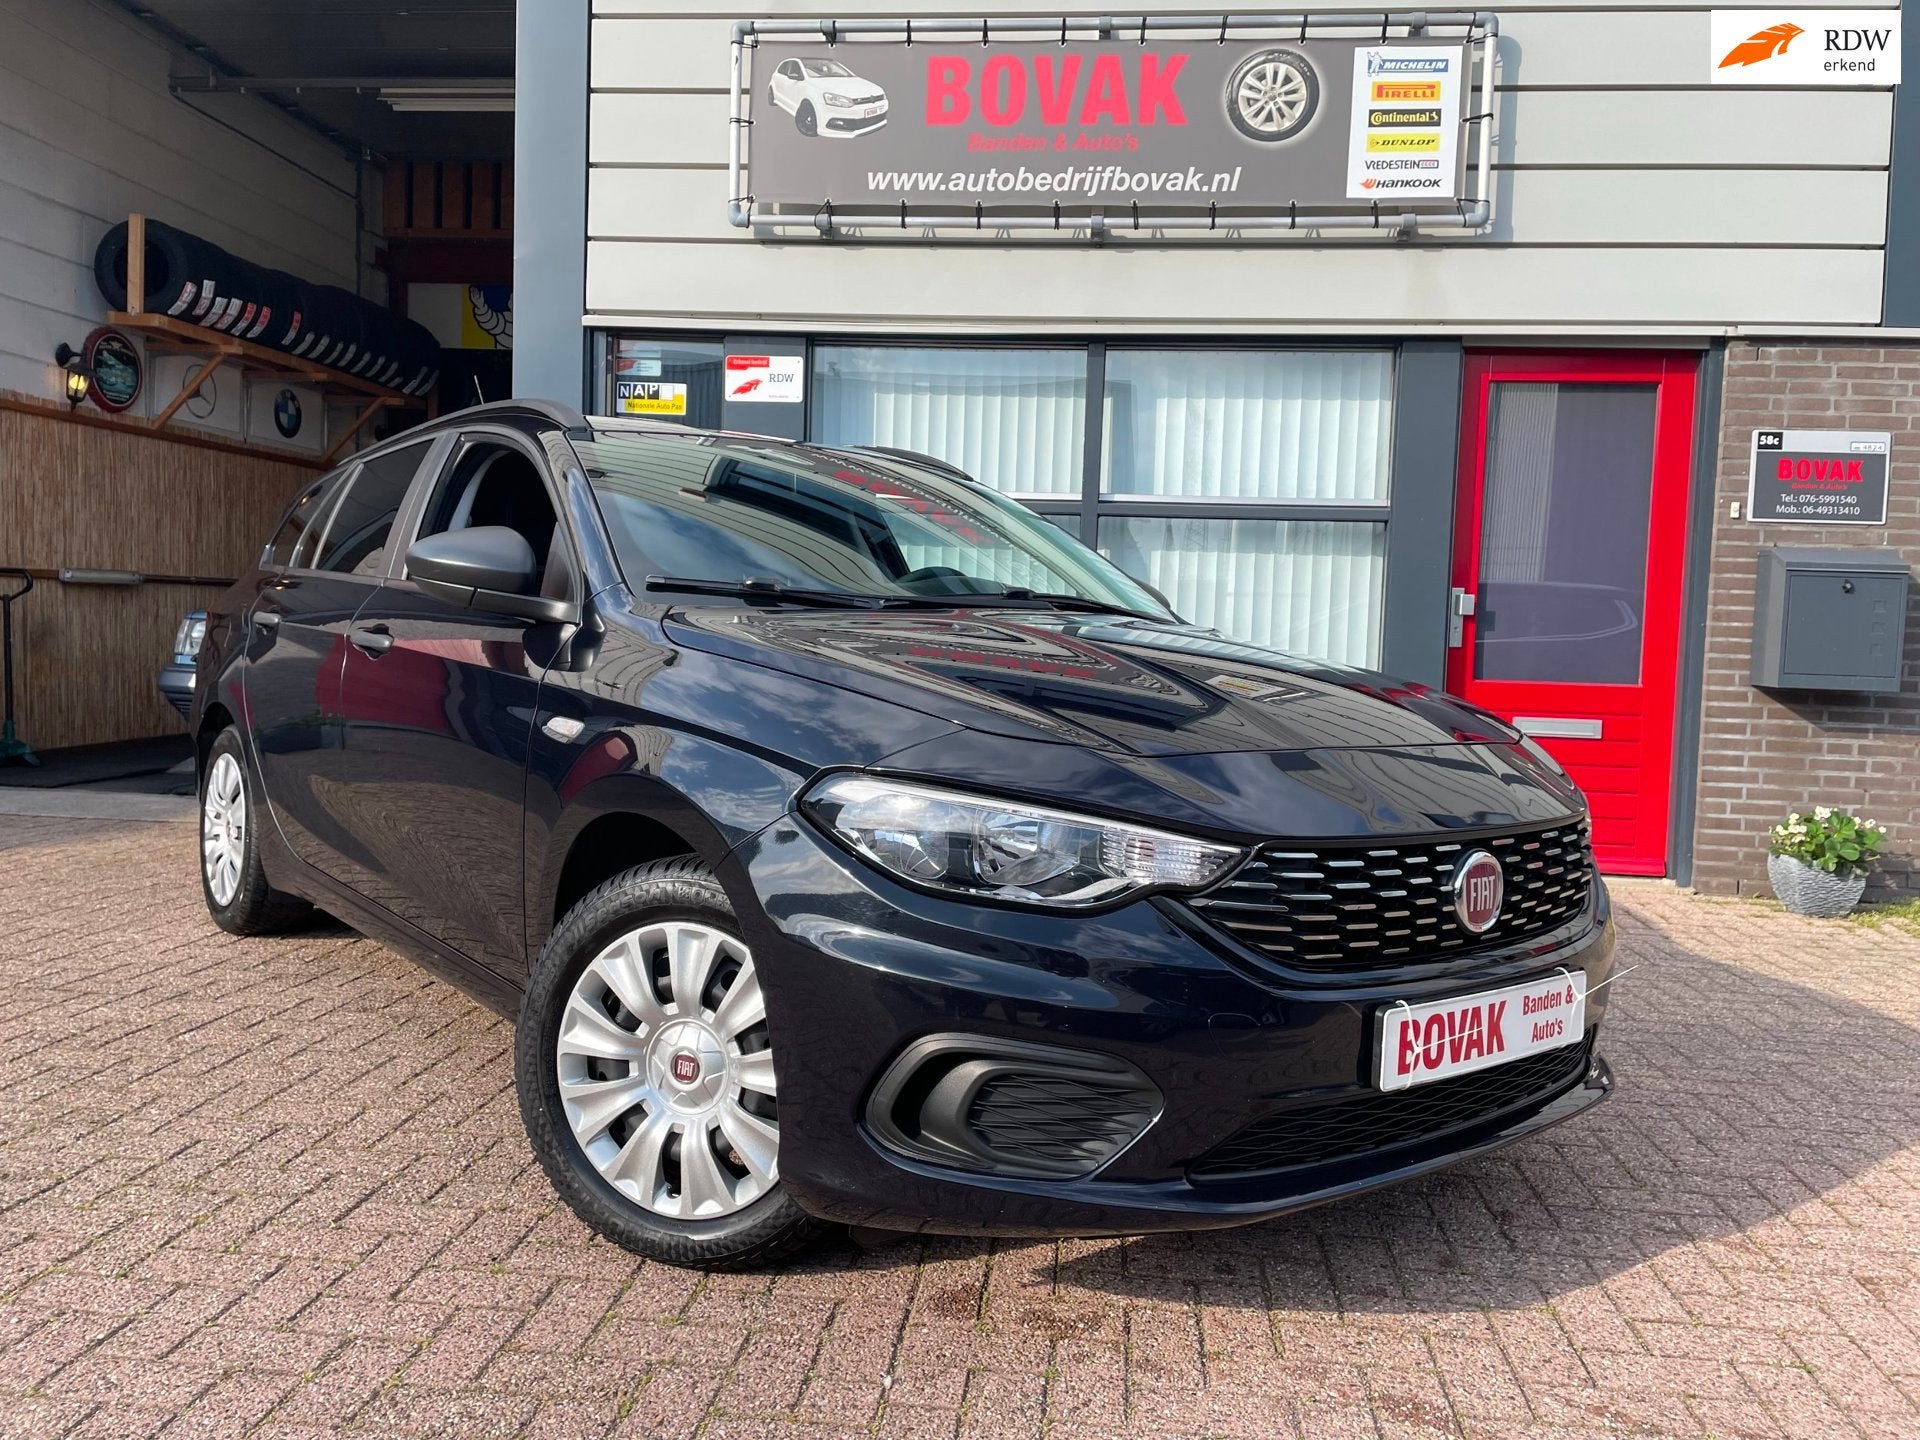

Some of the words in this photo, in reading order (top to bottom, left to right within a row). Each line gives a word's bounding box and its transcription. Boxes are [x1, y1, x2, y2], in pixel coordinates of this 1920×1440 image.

[1382, 61, 1446, 70] MICHELIN
[924, 53, 1190, 126] BOVAK
[1376, 84, 1435, 98] PIRELLI
[1370, 111, 1430, 125] Continental
[967, 134, 1046, 152] Banden
[1054, 134, 1067, 151] &
[1072, 133, 1140, 152] Auto's
[1365, 159, 1420, 170] VREDESTEIN
[867, 165, 1243, 197] www.autobedrijfbovak.nl
[768, 373, 795, 383] RDW
[656, 402, 670, 410] Auto
[1759, 435, 1779, 445] 58c
[1777, 458, 1864, 482] BOVAK
[1781, 494, 1798, 503] Tel.:
[1799, 494, 1857, 504] 076-5991540
[1776, 504, 1801, 514] Mob.:
[1802, 505, 1860, 515] 06-49313410
[1469, 875, 1496, 912] FIAT
[1522, 990, 1562, 1016] Banden
[1565, 984, 1573, 1004] &
[1397, 1000, 1507, 1076] BOVAK
[1531, 1018, 1563, 1043] Auto's
[677, 1059, 695, 1077] FIAT
